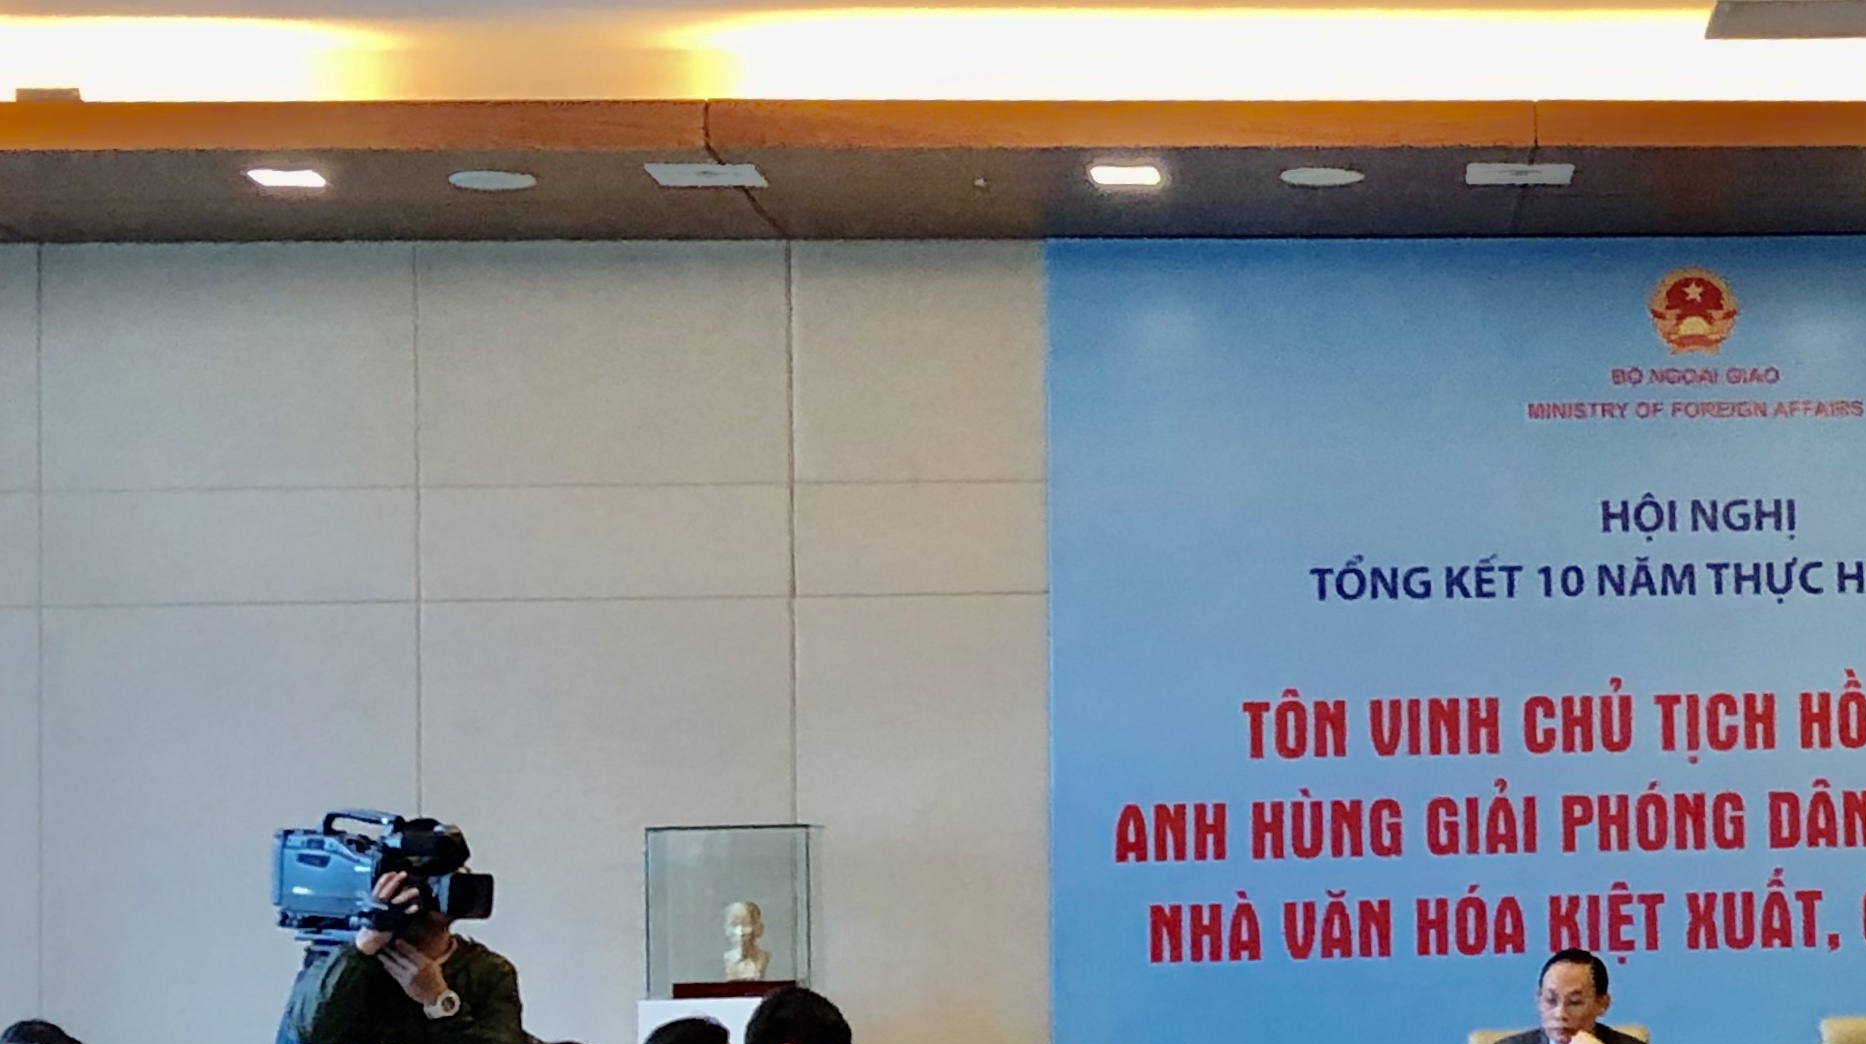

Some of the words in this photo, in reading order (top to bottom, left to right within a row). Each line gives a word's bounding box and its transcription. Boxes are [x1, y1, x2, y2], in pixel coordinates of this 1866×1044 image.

[1725, 366, 1780, 385] GIAO
[1527, 402, 1627, 420] MINISTRY
[1635, 402, 1664, 418] OF
[1671, 401, 1767, 418] FOREIGN
[1773, 400, 1864, 417] AFFAIRS
[1600, 492, 1677, 543] HỘI
[1690, 498, 1796, 541] NGHỊ
[1308, 553, 1433, 601] TỔNG
[1445, 552, 1524, 599] KẾT
[1537, 564, 1585, 598] 10
[1597, 555, 1697, 596] NĂM
[1706, 556, 1824, 604] THỰC
[1242, 688, 1347, 759] TÔN
[1370, 697, 1499, 756] VINH
[1523, 676, 1633, 754] CHỦ
[1654, 693, 1776, 764] TỊCH
[1114, 803, 1227, 863] ANH
[1251, 787, 1403, 860] HÙNG
[1426, 777, 1538, 855] GIẢI
[1561, 780, 1746, 853] PHÓNG
[1149, 889, 1262, 963] NHÀ
[1283, 889, 1392, 959] VĂN
[1415, 883, 1526, 956] HÓA
[1548, 881, 1665, 965] KIỆT
[1686, 867, 1841, 952] XUẤT,
